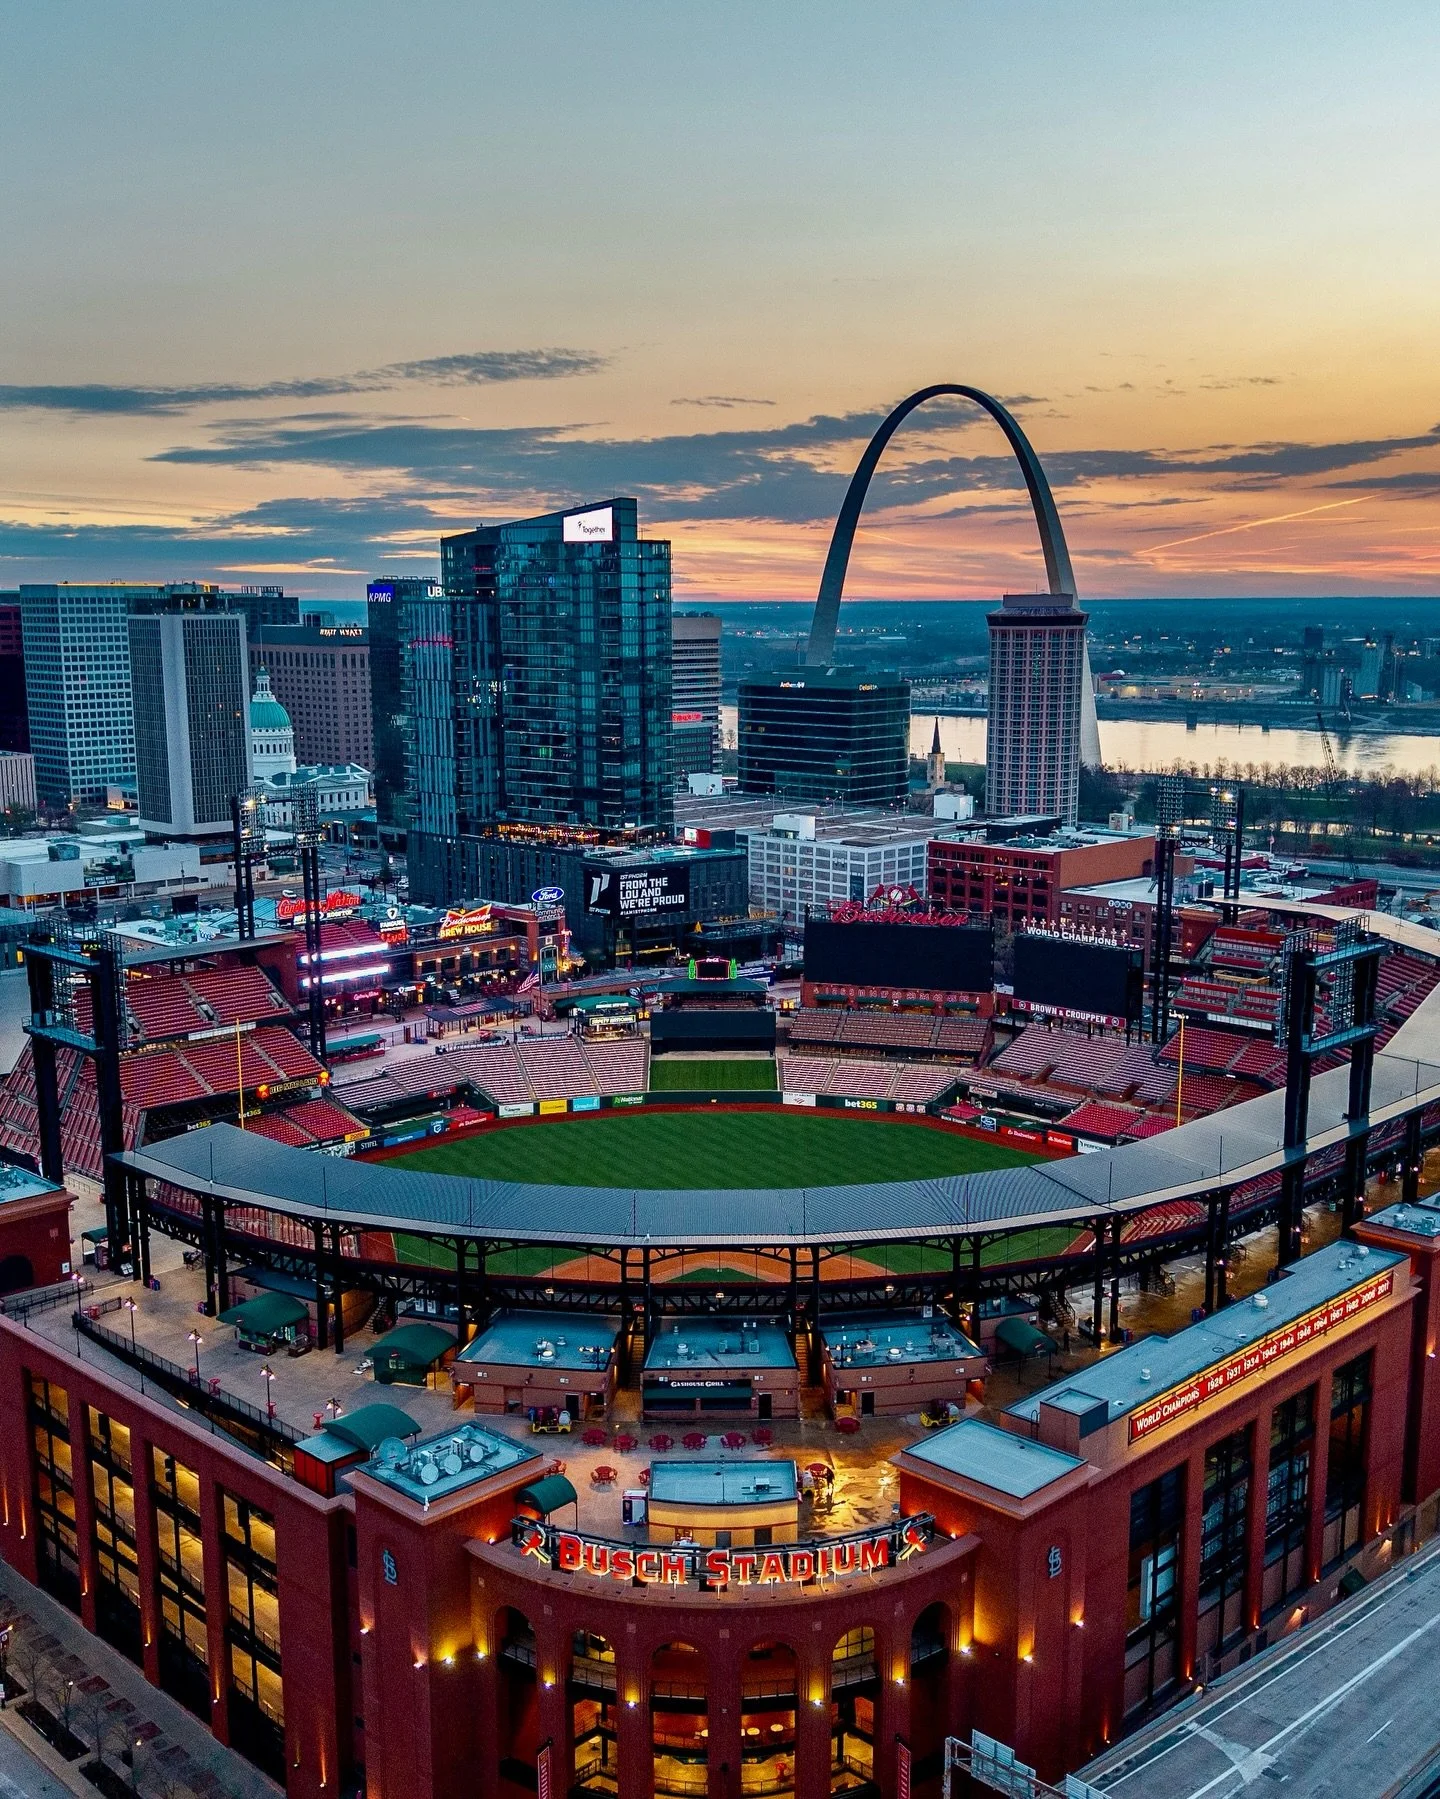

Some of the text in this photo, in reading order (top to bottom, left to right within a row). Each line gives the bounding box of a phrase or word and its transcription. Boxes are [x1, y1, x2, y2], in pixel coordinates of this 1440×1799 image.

[582, 525, 606, 535] Together
[368, 592, 392, 603] KPMG
[339, 628, 363, 637] HYATT
[620, 877, 668, 891] FROM THE
[538, 889, 558, 901] Ford
[620, 887, 661, 900] LOU AND
[620, 894, 685, 909] WE'RE PROUD
[440, 913, 491, 929] Budweiser
[440, 922, 492, 938] BREW HOUSE
[1027, 926, 1118, 947] WORLD CHAMPIONS
[1030, 1003, 1057, 1015] BROWN
[1065, 1010, 1106, 1024] CROUPPEN
[300, 1077, 319, 1087] LAND
[845, 1099, 877, 1109] bet365
[187, 1120, 211, 1130] bet365
[1136, 1410, 1161, 1431] WORLD
[1162, 1390, 1200, 1417] CHAMPIONS
[1207, 1375, 1224, 1391] 1926
[1227, 1365, 1241, 1381] 1931
[1243, 1355, 1260, 1371] 1934
[1262, 1345, 1278, 1360] 1942
[1297, 1326, 1312, 1341] 1946
[1313, 1316, 1328, 1331] 1964
[1377, 1281, 1390, 1295] 2011
[559, 1531, 890, 1587] BUSCH STADIUM
